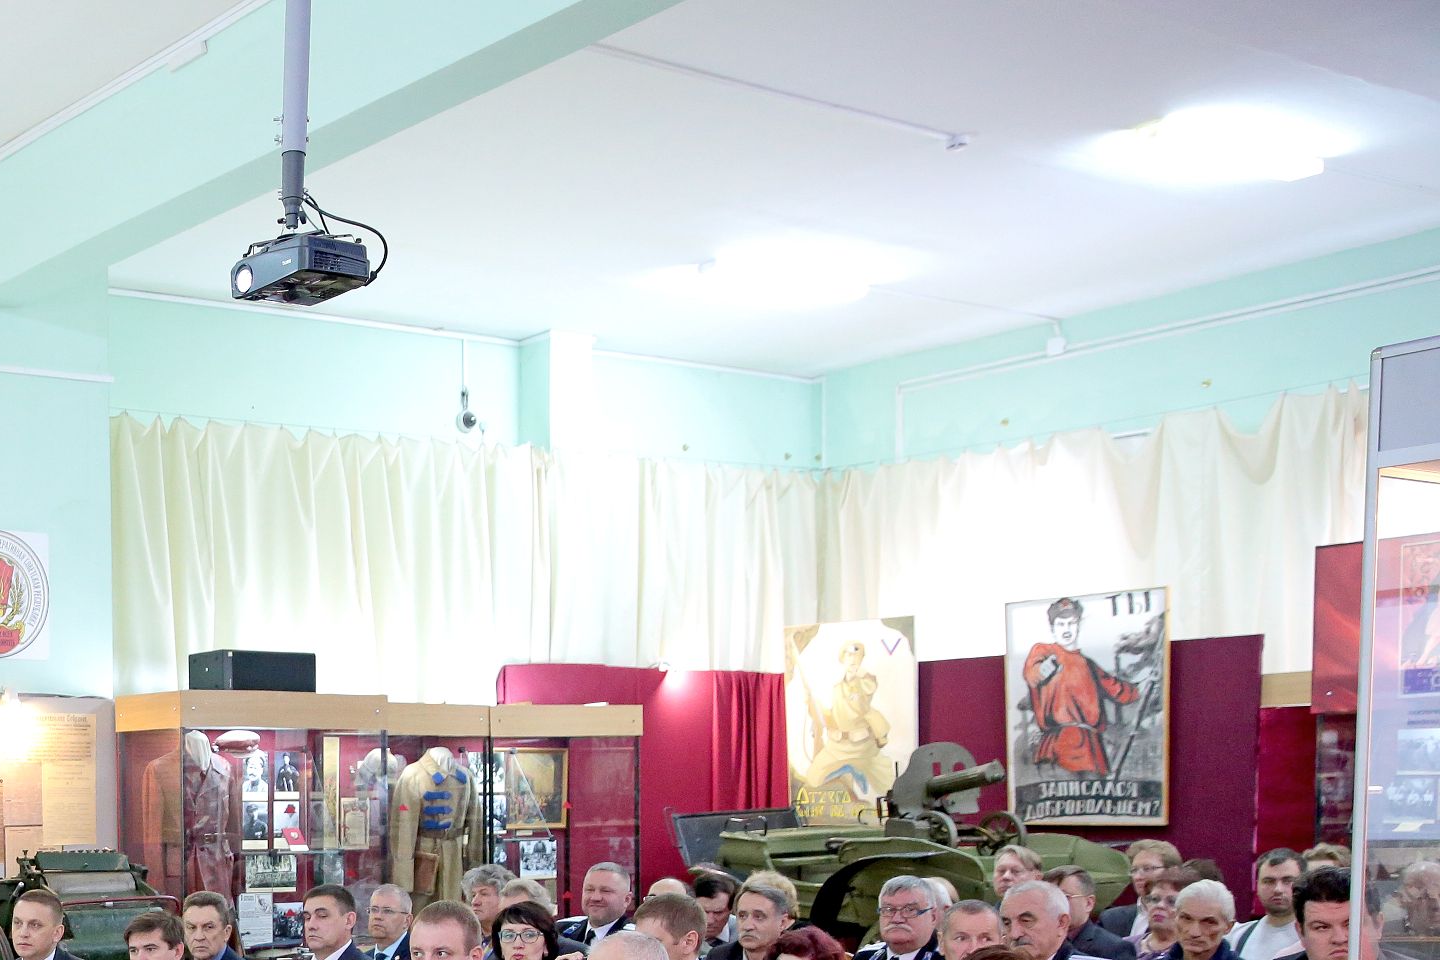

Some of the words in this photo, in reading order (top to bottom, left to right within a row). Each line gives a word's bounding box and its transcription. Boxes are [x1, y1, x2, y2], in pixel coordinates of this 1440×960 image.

[1105, 591, 1151, 616] ТЫ
[1038, 781, 1139, 799] ЗАПИСАЛСЯ
[1024, 799, 1160, 821] ДОБРОВОЛЬЦЕМ?
